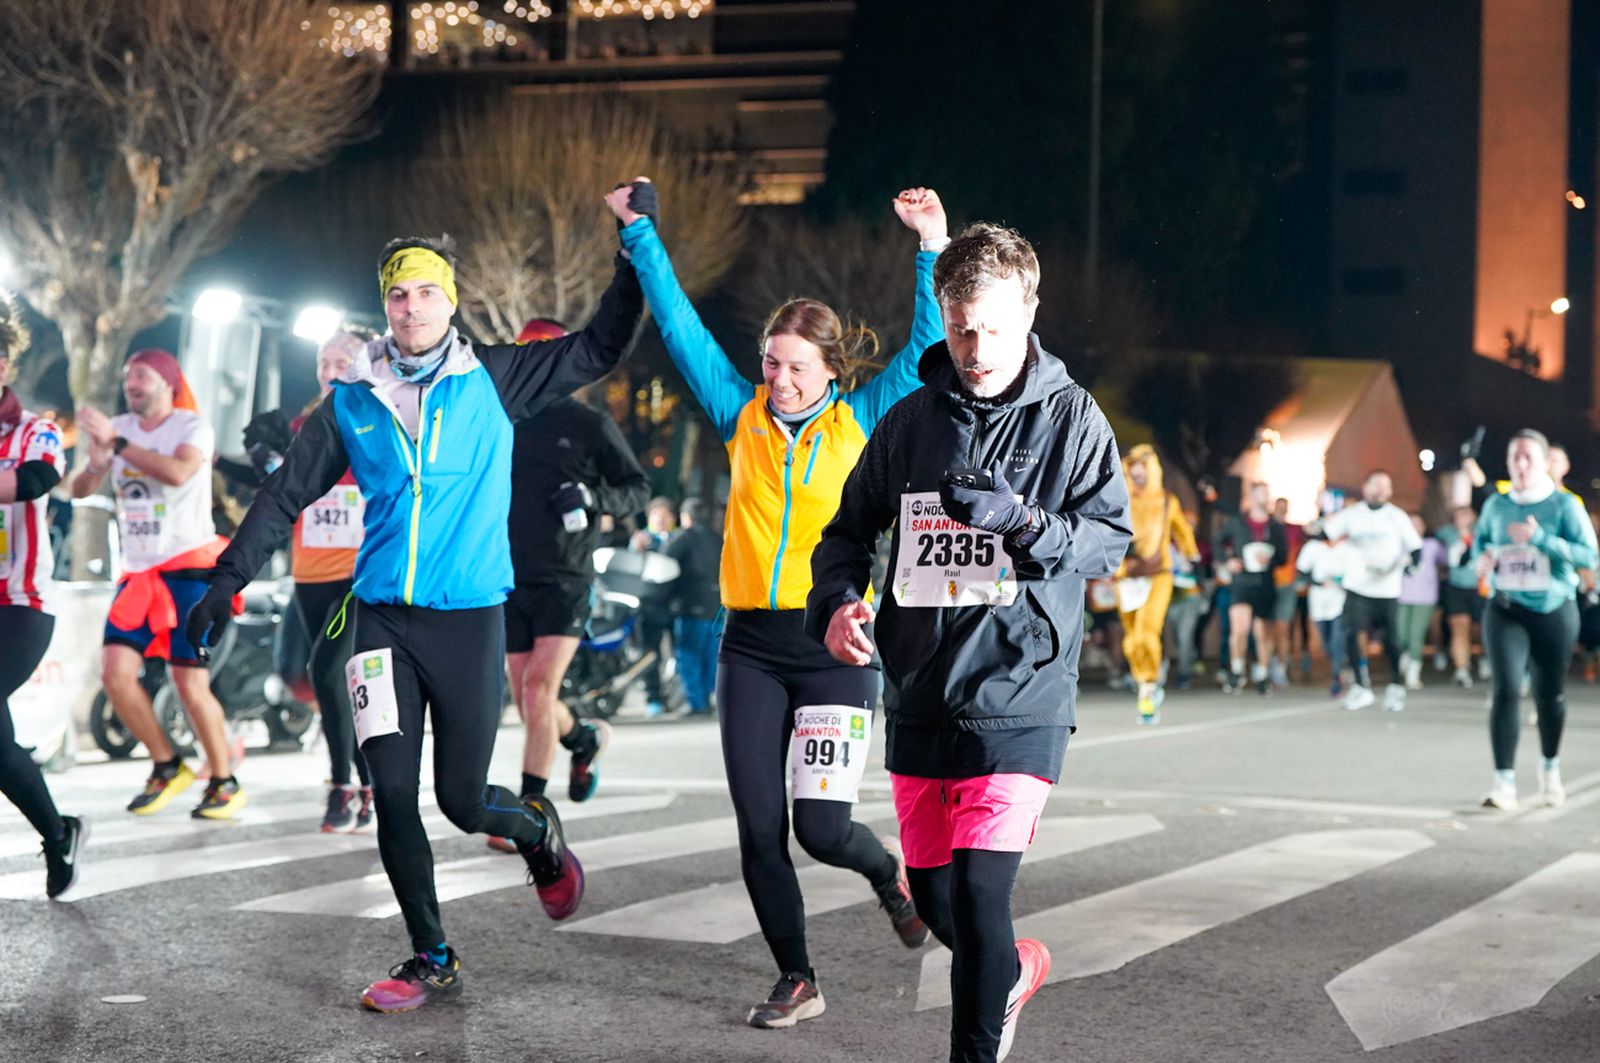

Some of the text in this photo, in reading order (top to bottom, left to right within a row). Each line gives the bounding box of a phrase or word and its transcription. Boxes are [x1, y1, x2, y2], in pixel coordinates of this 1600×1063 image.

[923, 504, 946, 516] NOC
[313, 508, 349, 526] 5421
[911, 519, 932, 531] SAN
[916, 533, 995, 567] 2335
[944, 569, 961, 577] Raul
[804, 715, 830, 725] NOCHE
[795, 727, 809, 738] SAN
[804, 739, 850, 768] 994
